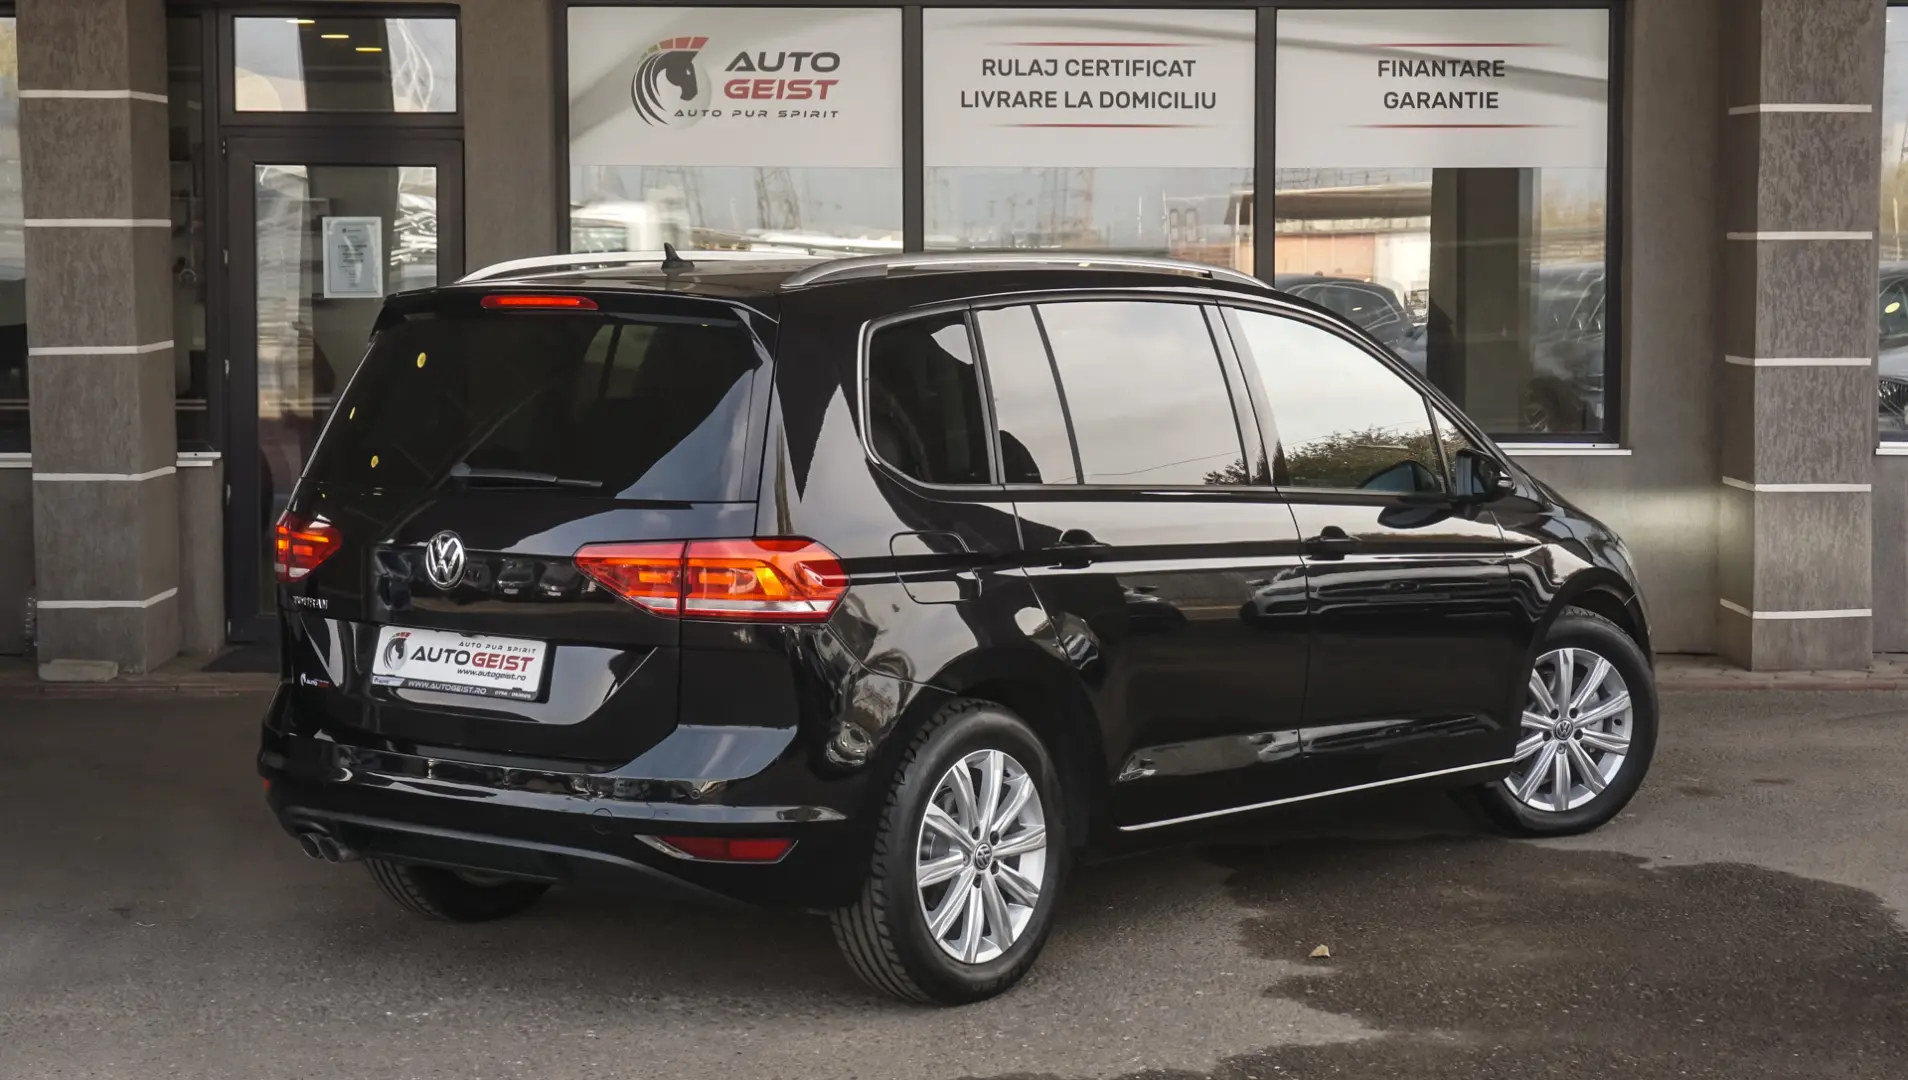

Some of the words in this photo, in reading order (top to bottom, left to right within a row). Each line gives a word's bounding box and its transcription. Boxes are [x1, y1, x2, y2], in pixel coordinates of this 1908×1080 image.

[724, 51, 840, 72] AUTO
[982, 59, 1058, 77] RULAJ
[1064, 59, 1196, 77] CERTIFICAT
[1377, 60, 1506, 78] FINANTARE
[723, 79, 840, 100] GEIST
[960, 90, 1058, 108] LIVRARE
[1064, 91, 1094, 108] LA
[1099, 91, 1217, 109] DOMICILIU
[1383, 91, 1499, 109] GARANTIE
[674, 109, 722, 118] AUTO
[731, 110, 768, 118] PUR
[778, 110, 840, 119] SPIRIT
[458, 641, 482, 649] AUTO
[506, 646, 537, 654] SPIRIT
[457, 668, 526, 681] www.autogeist.ro
[407, 680, 487, 695] WWW.AUTOGEIST.RO
